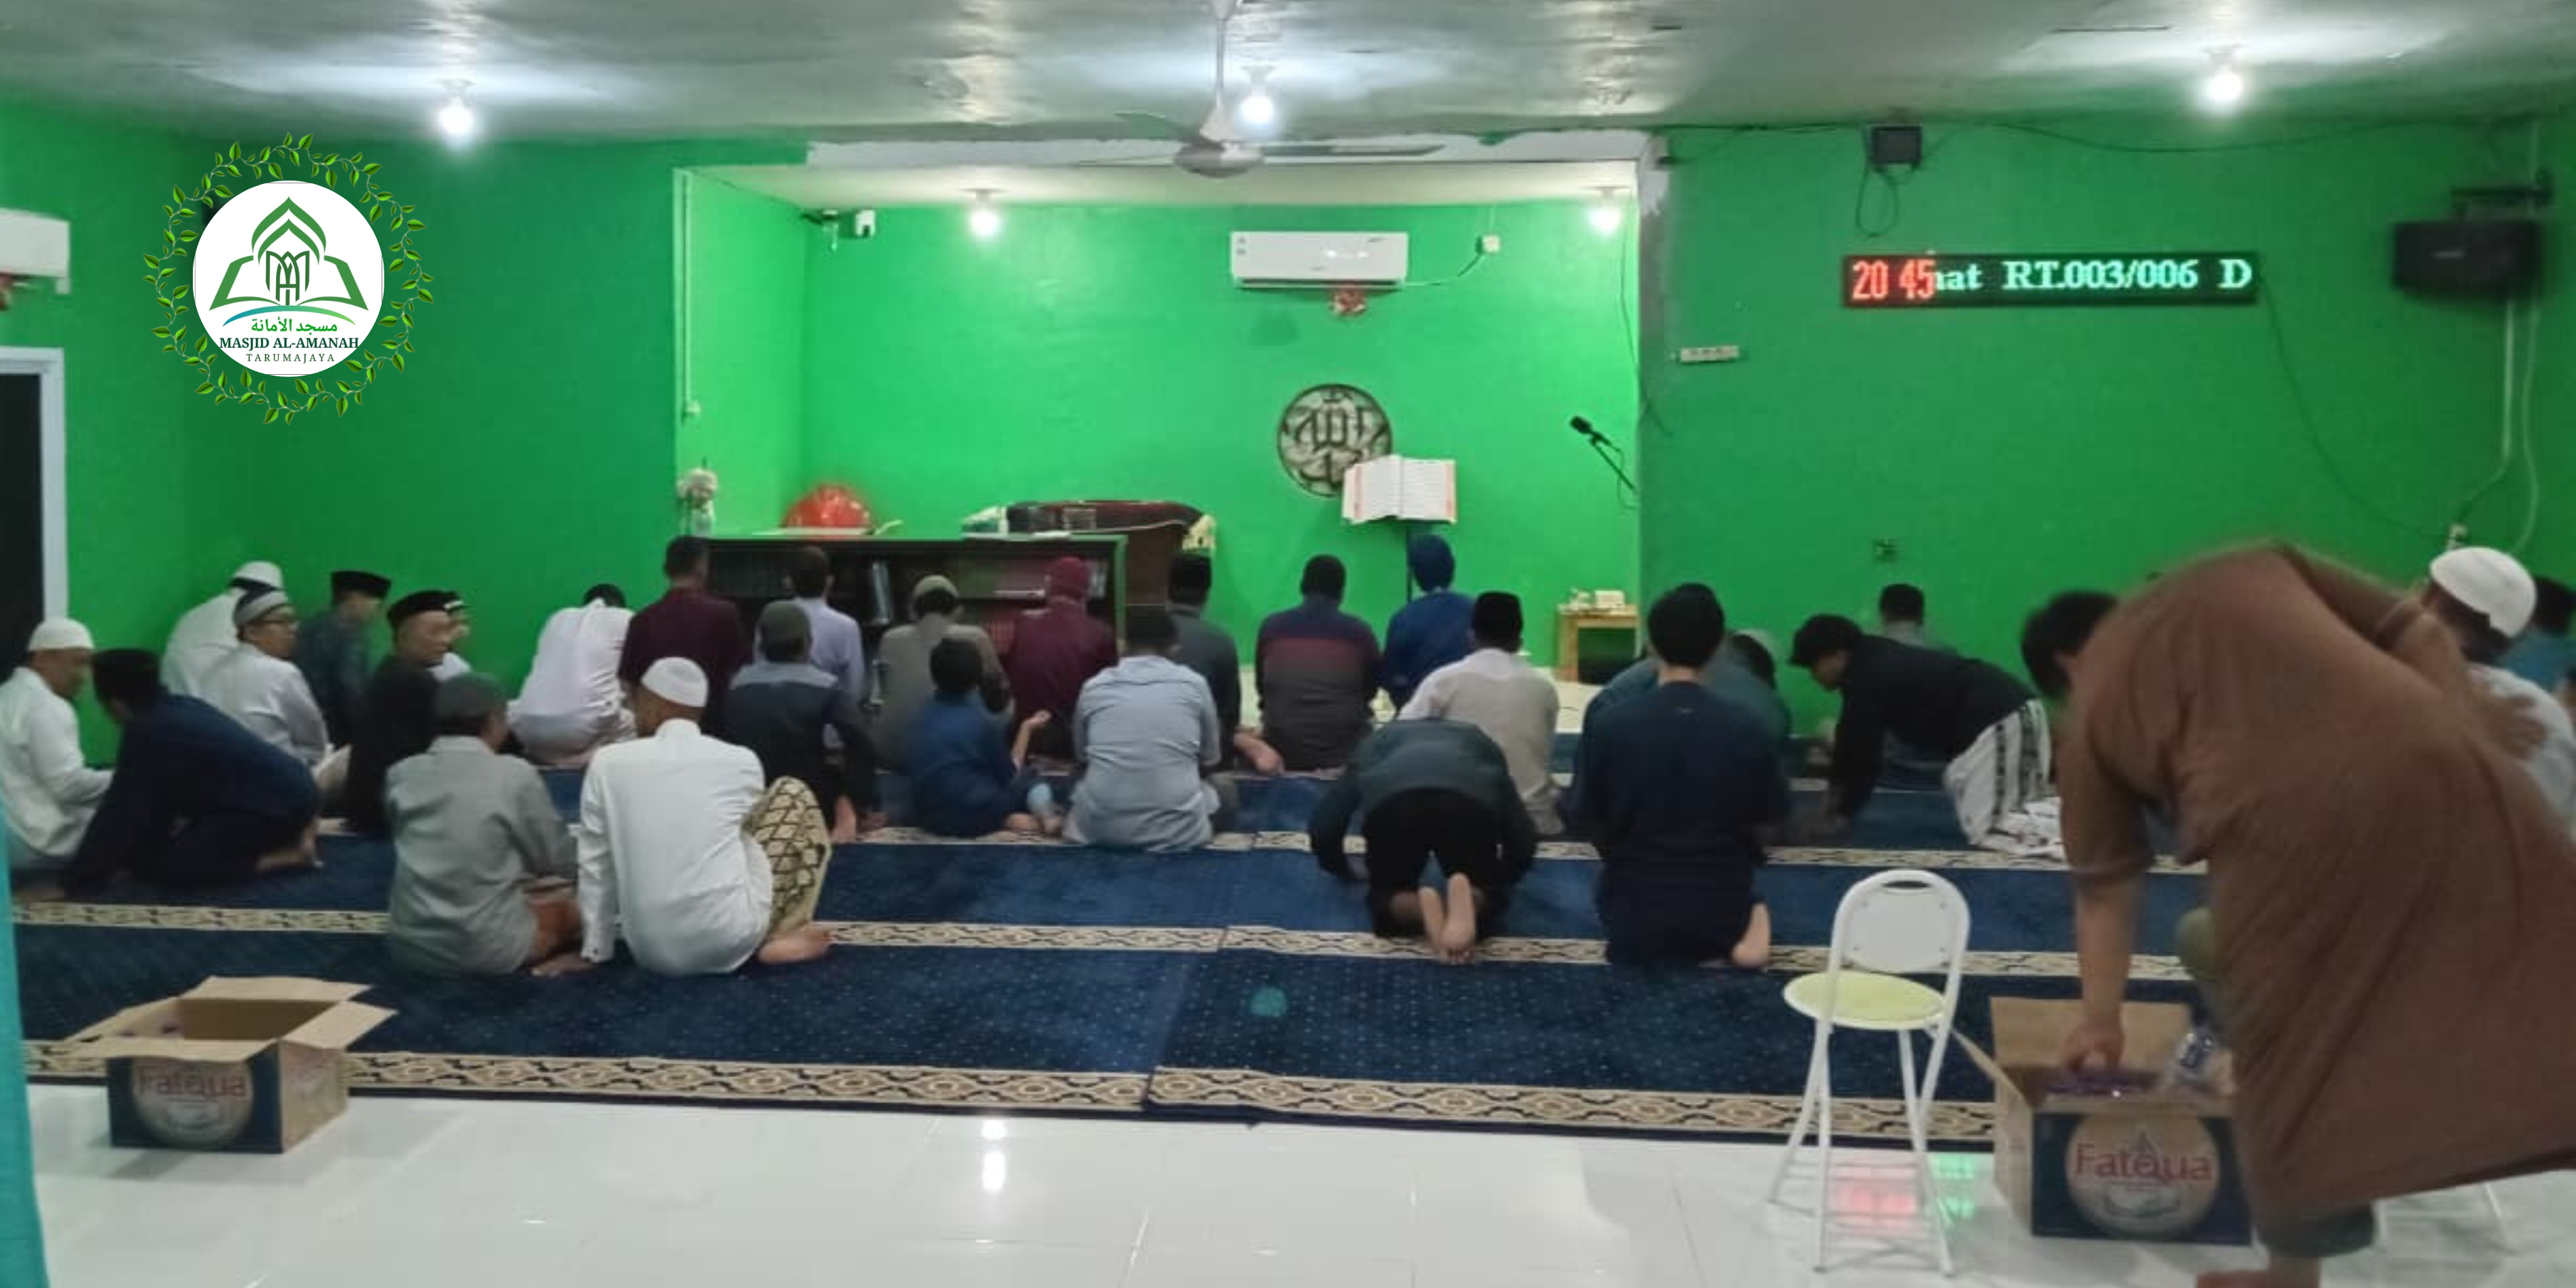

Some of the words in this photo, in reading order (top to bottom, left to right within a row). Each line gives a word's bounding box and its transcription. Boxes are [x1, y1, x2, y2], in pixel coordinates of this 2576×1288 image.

[1852, 260, 1888, 300] 20
[1899, 258, 1935, 300] 45
[2002, 259, 2199, 290] RT.003/006
[2218, 258, 2253, 289] D
